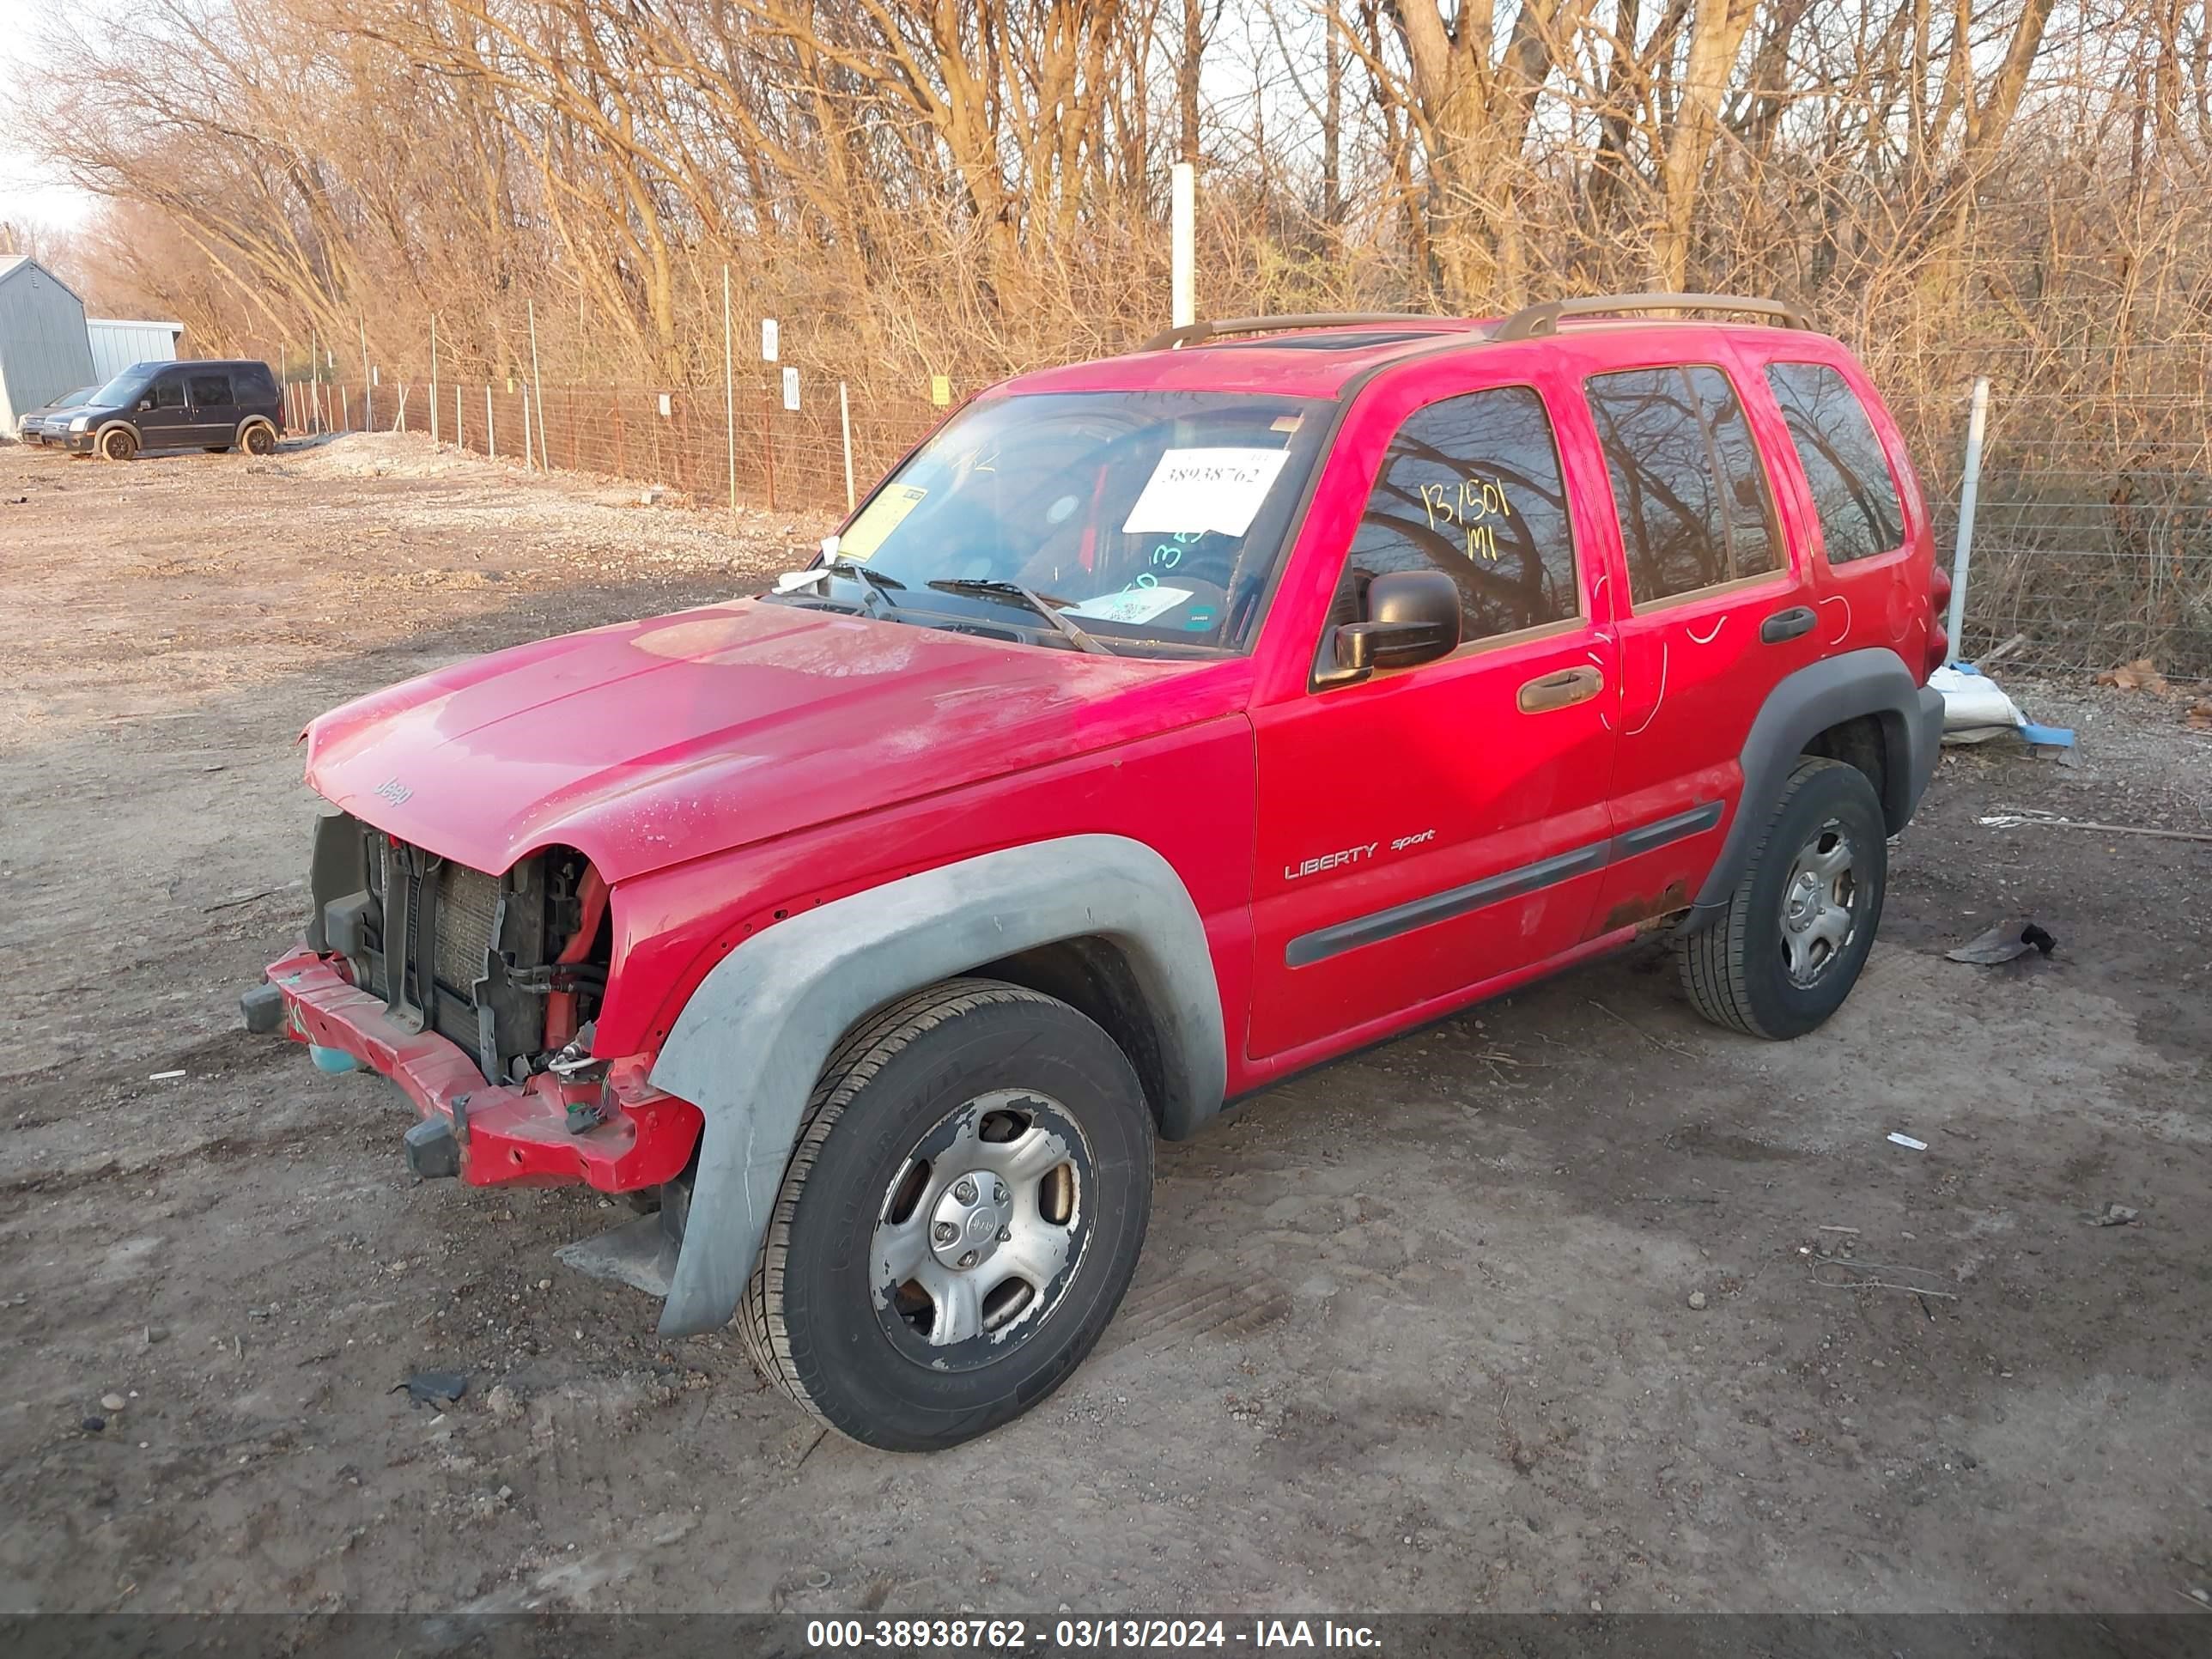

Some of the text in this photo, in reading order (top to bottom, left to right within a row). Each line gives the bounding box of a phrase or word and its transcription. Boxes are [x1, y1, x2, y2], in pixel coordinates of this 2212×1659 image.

[1162, 466, 1261, 483] 38938762
[372, 775, 414, 807] Jeep
[1284, 842, 1379, 880] LIBERTY
